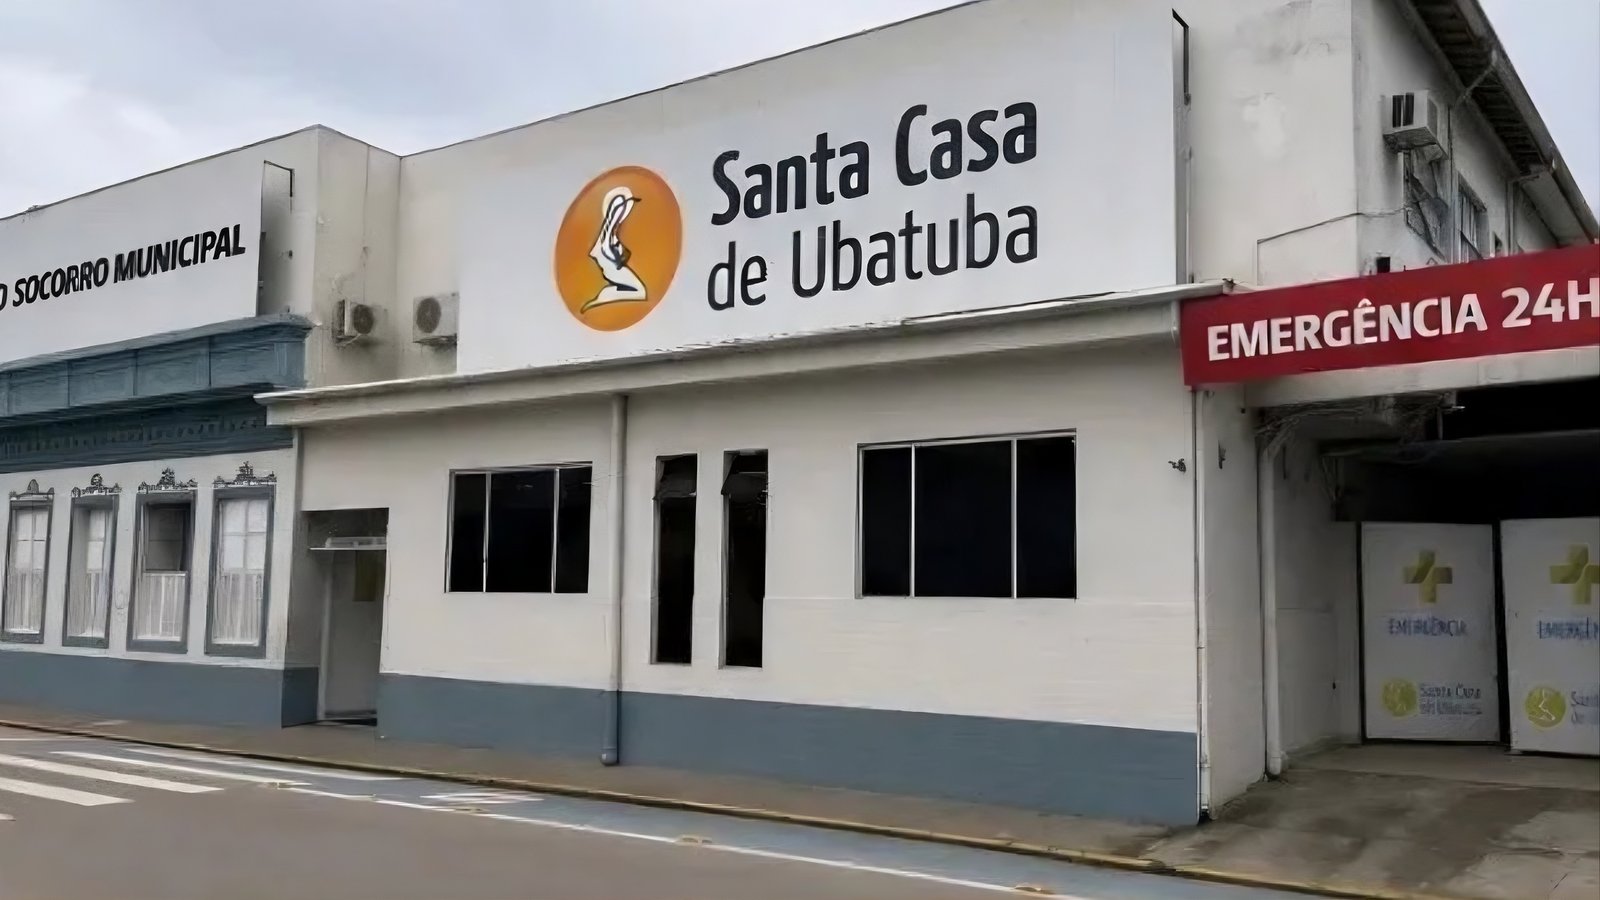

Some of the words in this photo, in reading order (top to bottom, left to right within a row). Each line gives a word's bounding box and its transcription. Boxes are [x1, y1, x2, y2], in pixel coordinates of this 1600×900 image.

[712, 132, 870, 226] Santa
[895, 102, 1037, 187] Casa
[13, 258, 109, 307] SOCORRO
[114, 224, 246, 283] MUNICIPAL
[707, 241, 768, 311] de
[792, 192, 1038, 298] Ubatuba
[1207, 293, 1488, 362] EMERGÊNCIA
[1502, 277, 1600, 328] 24H
